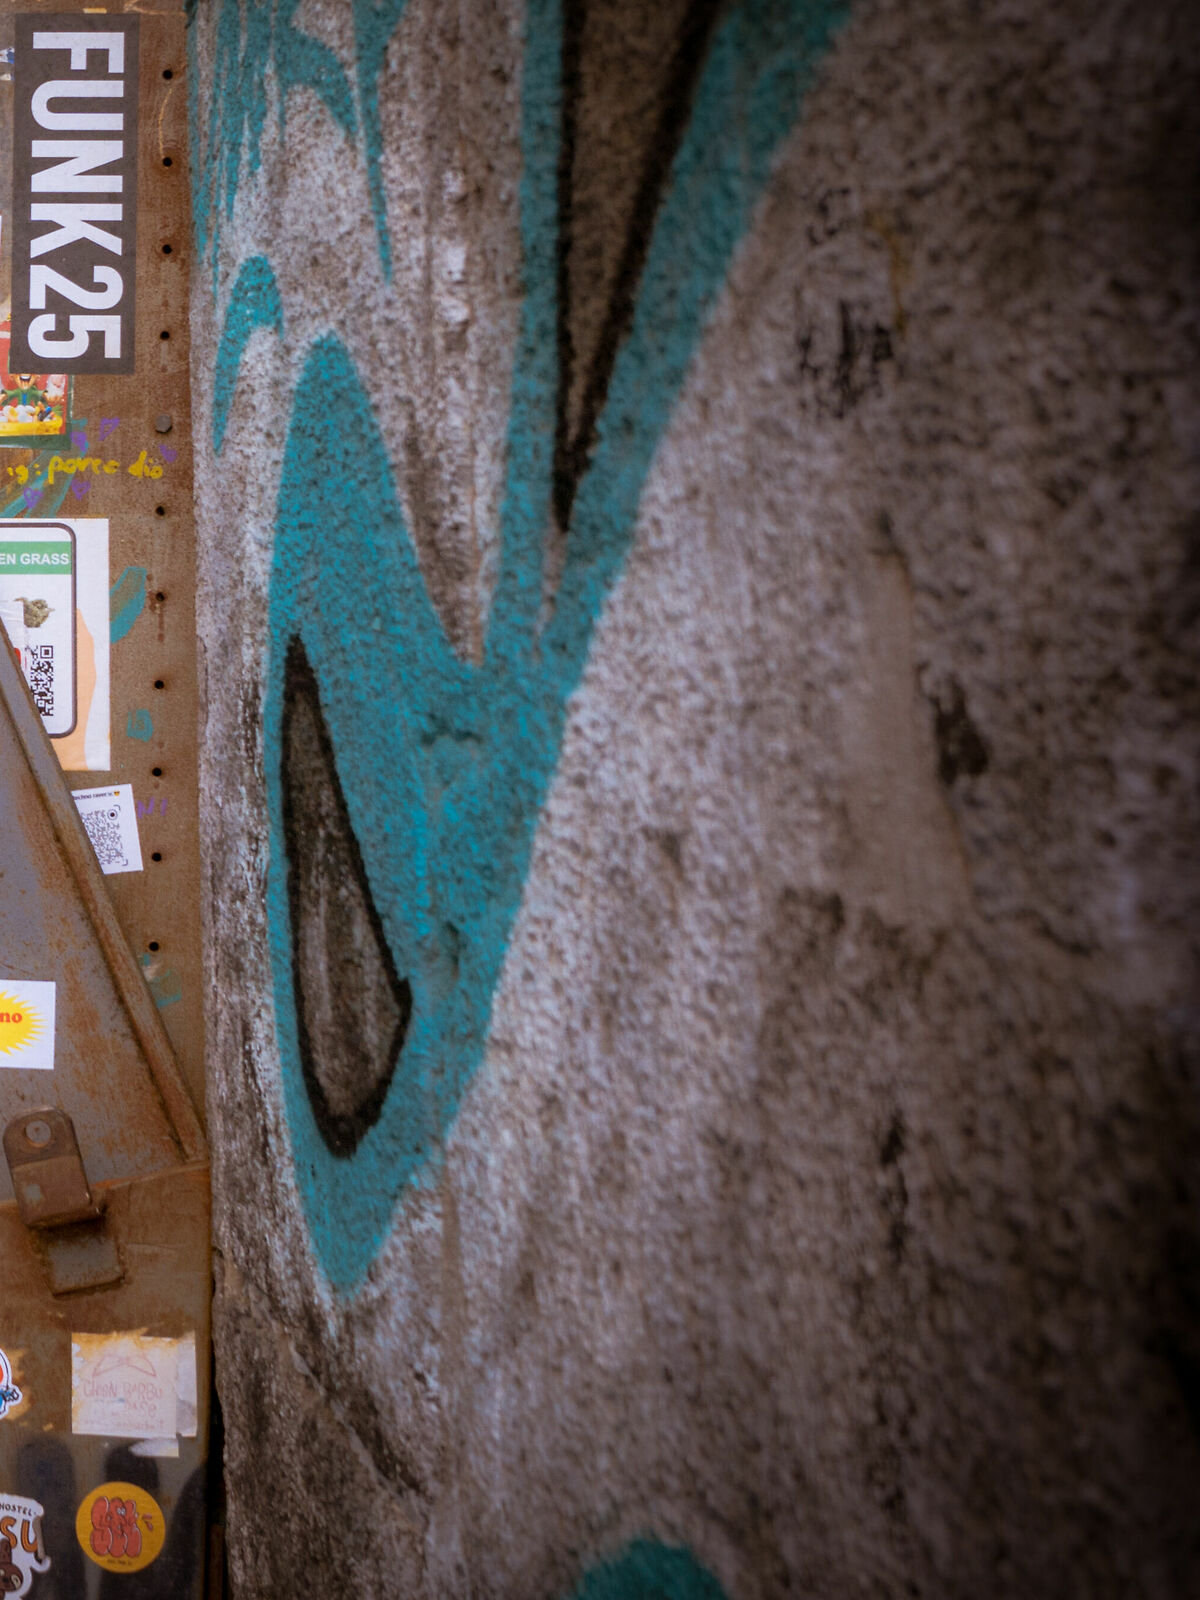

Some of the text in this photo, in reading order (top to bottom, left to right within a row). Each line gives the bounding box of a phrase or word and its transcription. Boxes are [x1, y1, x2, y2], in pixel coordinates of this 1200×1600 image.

[27, 31, 125, 359] FUNK25
[20, 552, 70, 565] GRASS
[0, 1502, 33, 1517] HOSTEL
